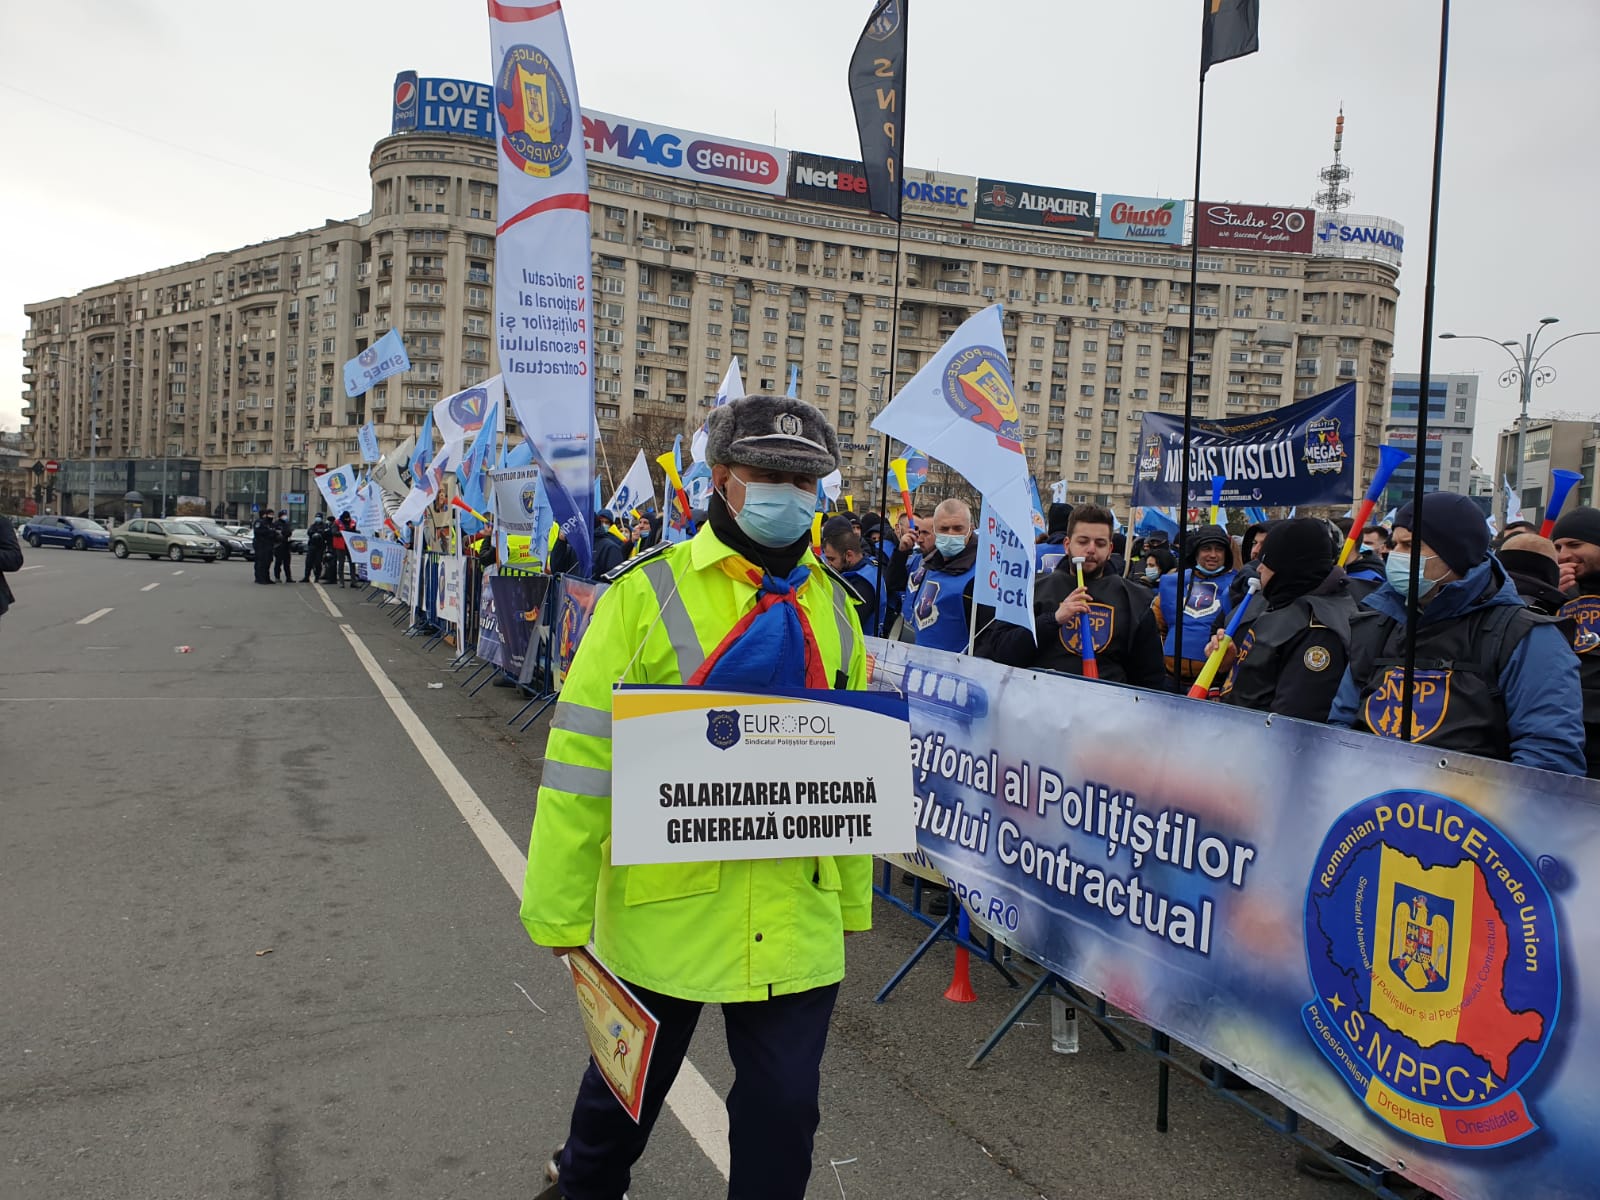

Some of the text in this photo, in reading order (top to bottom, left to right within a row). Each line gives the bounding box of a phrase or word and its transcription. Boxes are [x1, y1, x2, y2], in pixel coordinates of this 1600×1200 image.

[426, 81, 490, 108] LOVE
[395, 110, 414, 120] pepsi
[425, 105, 478, 130] LIVE
[696, 149, 770, 176] genius
[796, 166, 867, 193] NetBe
[1018, 192, 1090, 218] ALBACHER
[1110, 202, 1172, 226] Giusto
[1126, 225, 1167, 237] Natura
[1208, 206, 1305, 233] Studio 20
[1340, 226, 1404, 253] SANADOR
[1222, 441, 1296, 481] VASLUI
[1305, 445, 1342, 460] MEGAS
[744, 714, 835, 734] EUROPOL
[659, 777, 877, 808] SALARIZAREA PRECARĂ
[911, 733, 1254, 886] ațional al Polițiștilor
[667, 812, 872, 844] GENEREAZĂ CORUPȚIE
[914, 793, 1212, 953] alului Contractual
[1320, 803, 1540, 971] Romanian POLICE Trade Union
[1355, 876, 1367, 924] Sindicatul
[1429, 1011, 1437, 1021] al
[1478, 919, 1496, 982] Contractual
[1308, 1005, 1369, 1091] Profesionalism
[1378, 1091, 1434, 1127] Dreptate
